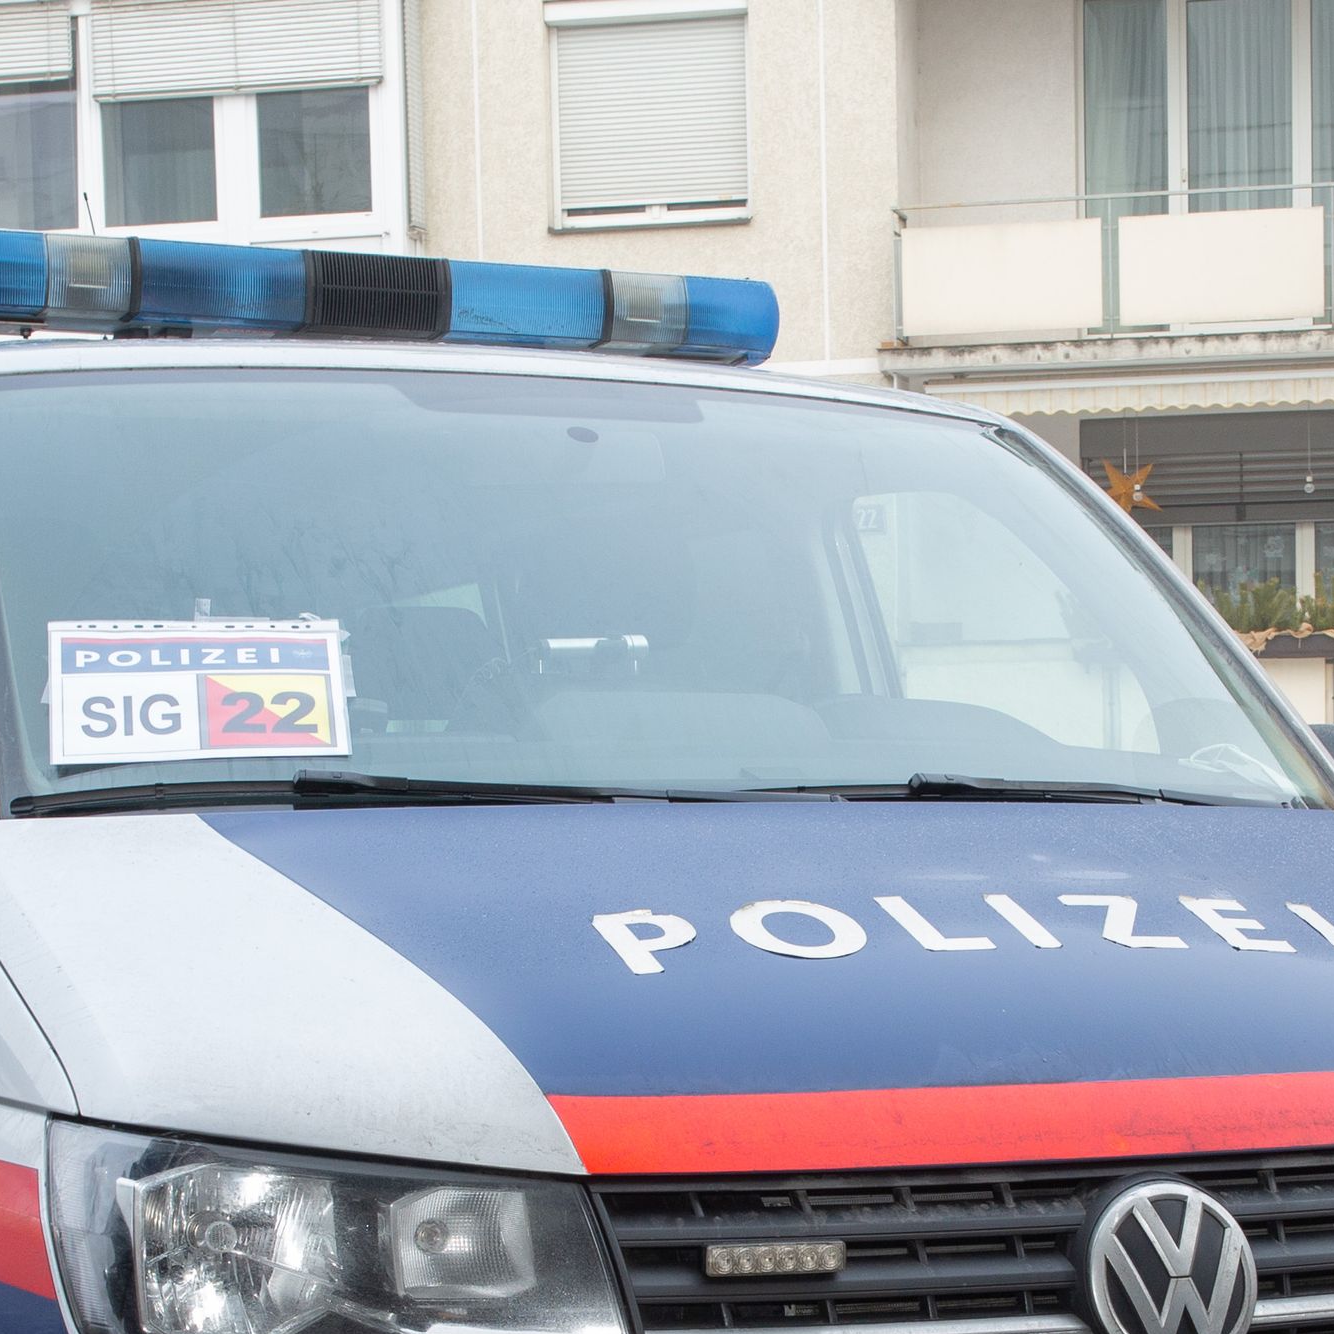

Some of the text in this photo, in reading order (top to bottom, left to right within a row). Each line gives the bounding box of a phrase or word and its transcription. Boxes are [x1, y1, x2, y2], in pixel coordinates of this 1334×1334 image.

[74, 647, 281, 668] POLIZEI
[80, 690, 319, 738] SIG 22
